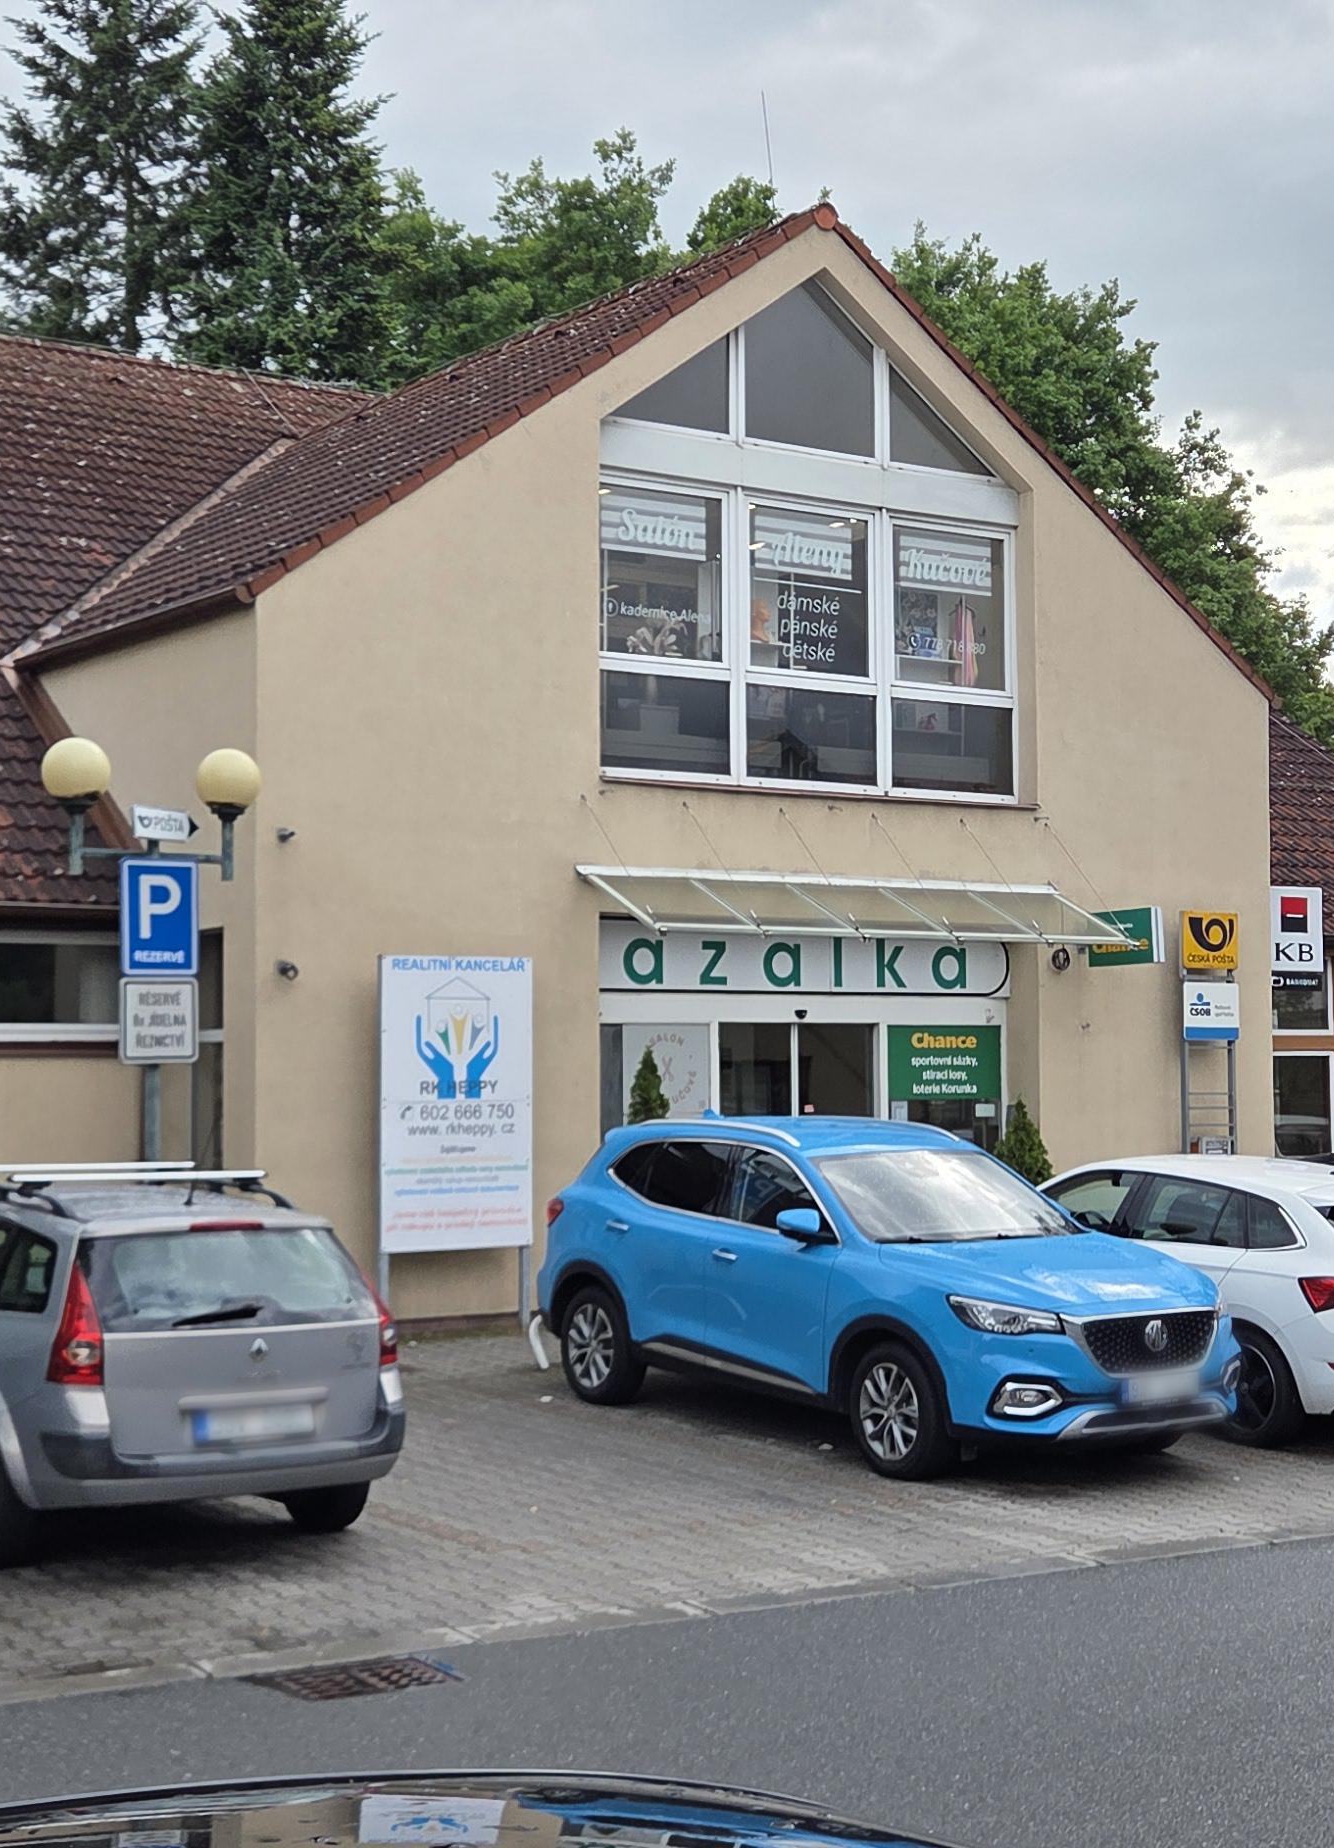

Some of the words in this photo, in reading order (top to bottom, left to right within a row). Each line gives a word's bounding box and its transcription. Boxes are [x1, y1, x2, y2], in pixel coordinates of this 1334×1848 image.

[777, 590, 841, 615] dámské
[780, 615, 838, 639] pánské
[782, 640, 836, 662] dětské
[153, 814, 185, 834] POŠTA
[139, 874, 182, 939] P
[134, 949, 185, 964] REZERVÉ
[1187, 953, 1211, 963] ČESKÁ
[1212, 953, 1235, 964] POŠTA
[1274, 942, 1314, 962] KB
[391, 957, 451, 971] REALITNÍ
[455, 957, 526, 972] KANCELÁŘ
[623, 937, 967, 989] azalka
[910, 1032, 978, 1049] Chance
[419, 1080, 440, 1095] RK
[446, 1079, 498, 1095] HEPPY
[912, 1083, 941, 1095] loterie
[942, 1083, 978, 1094] Korunka
[420, 1105, 449, 1120] 602
[487, 1103, 515, 1119] 750
